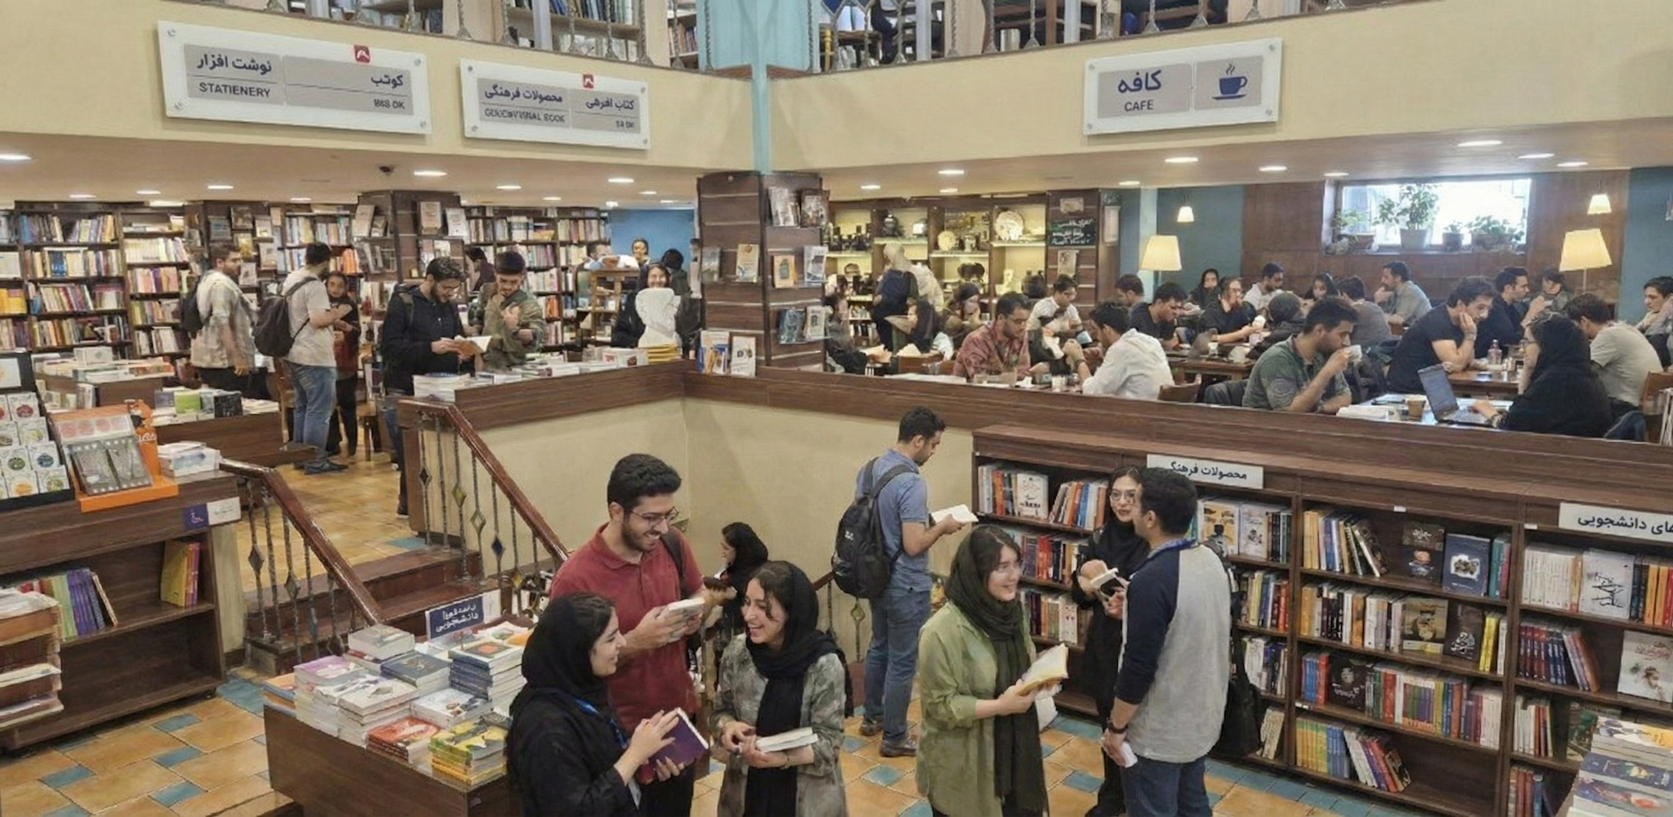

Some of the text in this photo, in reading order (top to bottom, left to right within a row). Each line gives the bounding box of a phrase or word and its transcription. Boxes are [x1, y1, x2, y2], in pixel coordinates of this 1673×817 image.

[196, 54, 272, 76] نوشت افزار
[198, 81, 271, 98] STATIENERY
[1117, 69, 1162, 94] کافه
[485, 84, 563, 104] محصولات فرهنگی
[614, 99, 635, 111] کتاب
[1124, 99, 1154, 112] CAFE
[1170, 461, 1247, 480] محصولات فرهنگ
[1577, 515, 1647, 530] دانشجویی
